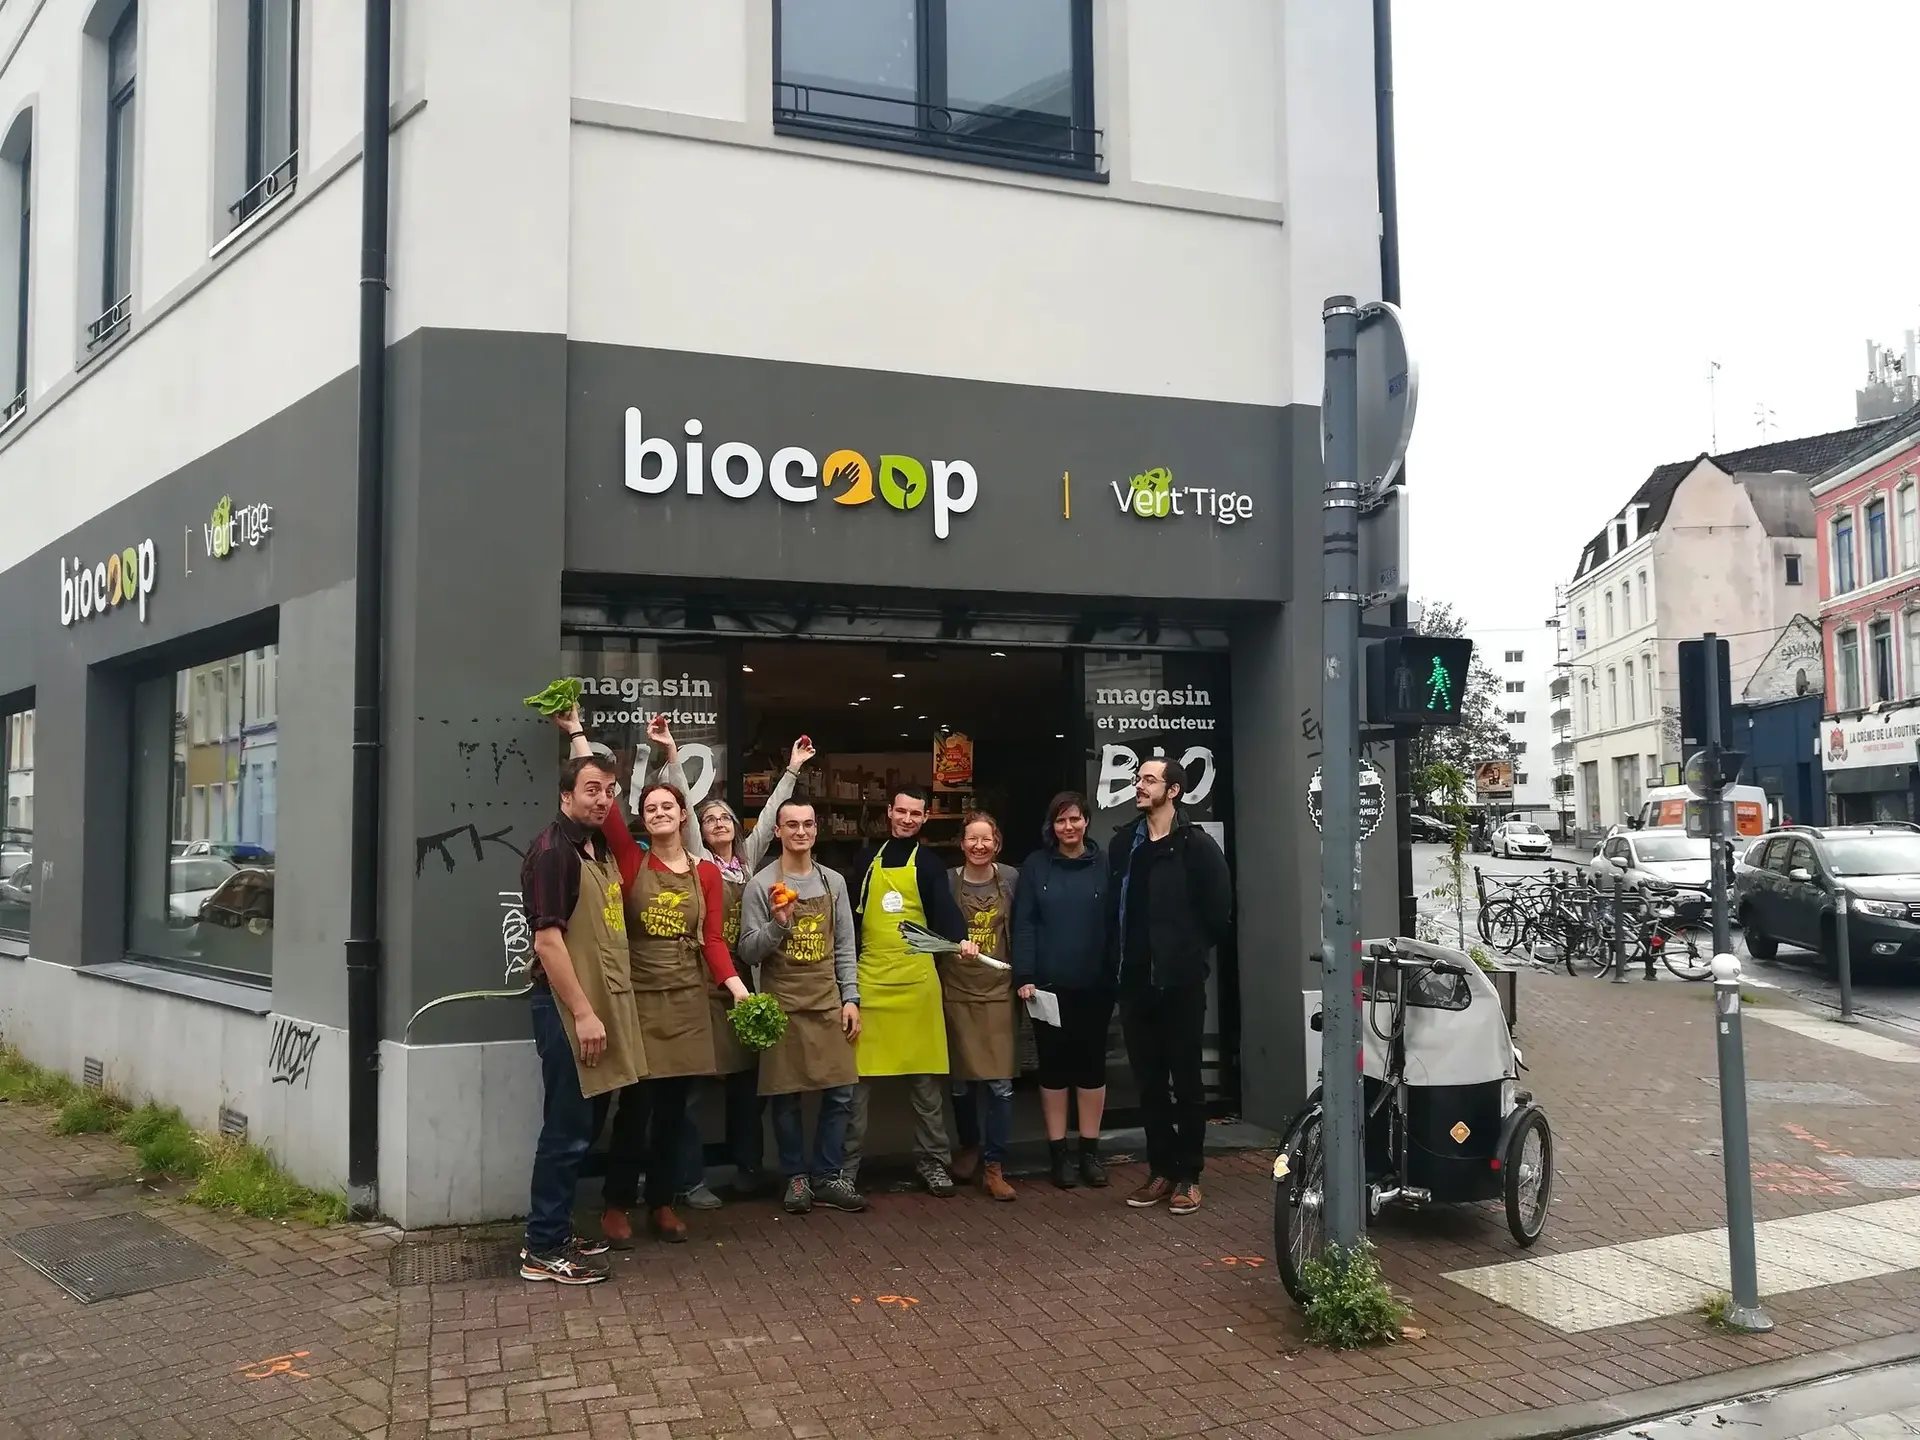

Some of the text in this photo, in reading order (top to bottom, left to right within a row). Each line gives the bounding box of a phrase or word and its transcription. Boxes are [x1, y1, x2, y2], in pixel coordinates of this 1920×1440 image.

[624, 406, 979, 540] biocoop
[60, 537, 155, 626] biocoop
[1096, 684, 1211, 711] magasin
[1096, 714, 1216, 734] et producteur
